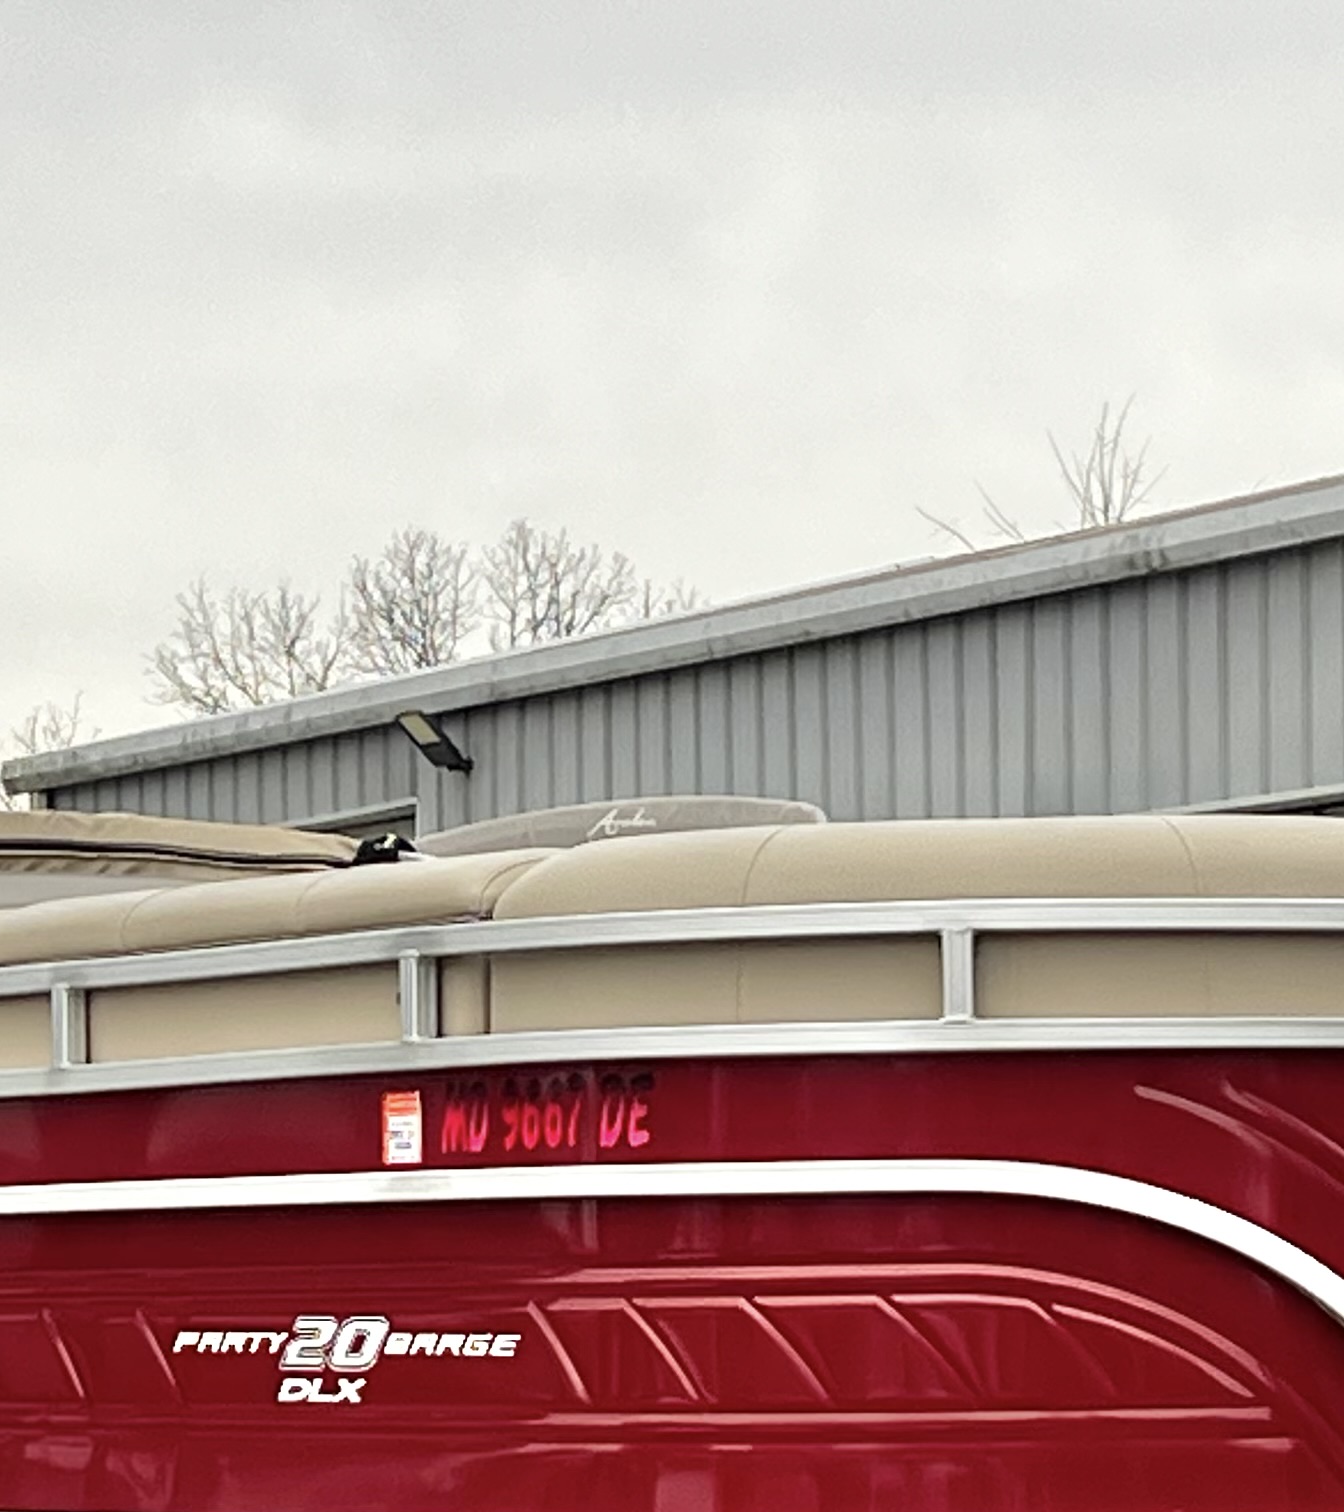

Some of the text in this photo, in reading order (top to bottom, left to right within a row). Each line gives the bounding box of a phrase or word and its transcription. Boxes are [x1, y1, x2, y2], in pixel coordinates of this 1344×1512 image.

[173, 1315, 521, 1373] PARTY 20 BARGE
[277, 1378, 367, 1403] DLX
